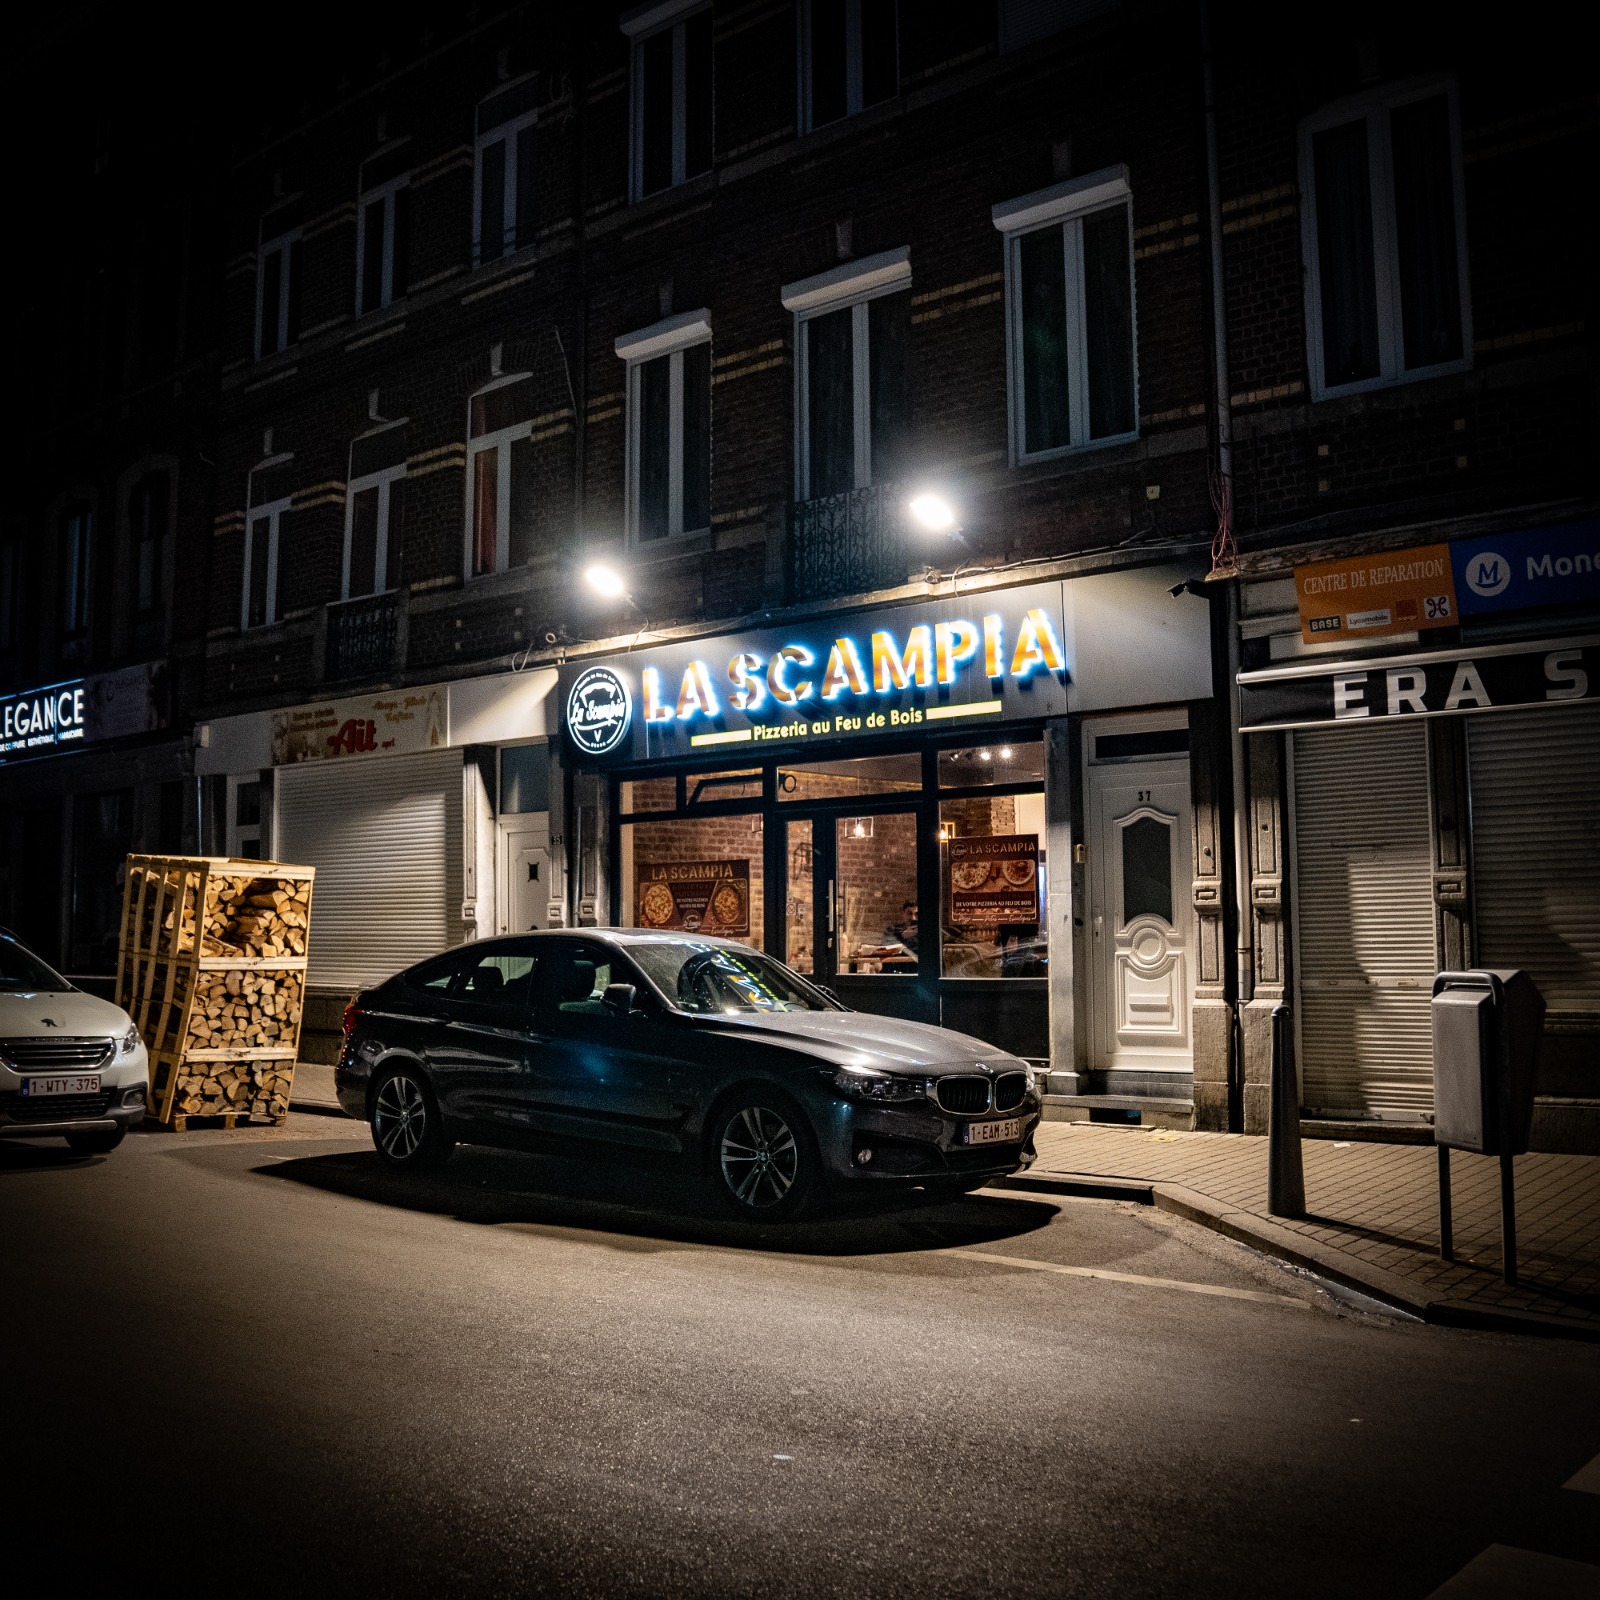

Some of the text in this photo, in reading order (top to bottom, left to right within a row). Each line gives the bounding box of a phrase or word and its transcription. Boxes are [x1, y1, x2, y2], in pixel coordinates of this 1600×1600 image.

[1304, 558, 1443, 595] CENTRE DE REPARATION
[1311, 618, 1339, 630] BASE
[642, 608, 1065, 722] LA SCAMPIA
[1333, 648, 1589, 719] ERA S
[753, 708, 922, 741] Pizzeria au Feu de Bois
[1138, 790, 1151, 802] 37
[970, 845, 983, 855] LA
[986, 842, 1035, 854] SCAMPIA
[652, 863, 733, 880] LA SCAMPIA
[31, 1077, 98, 1093] 1-WTY-375
